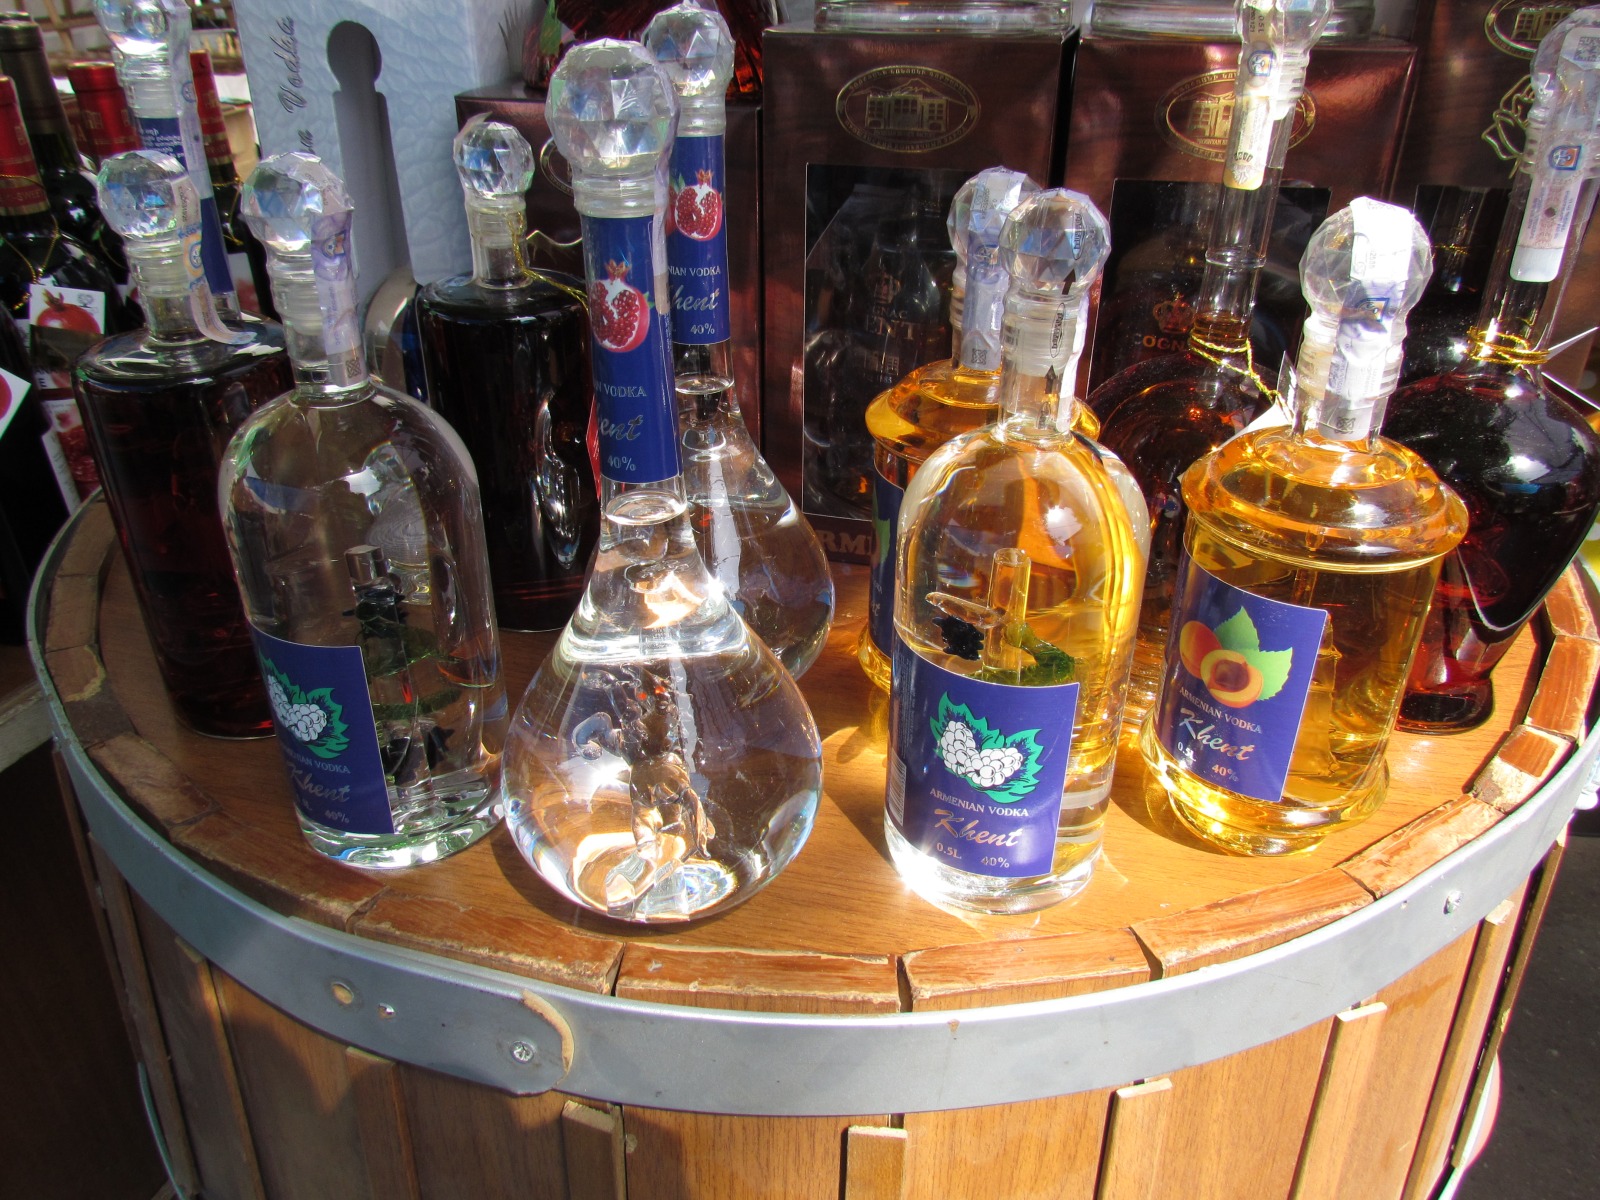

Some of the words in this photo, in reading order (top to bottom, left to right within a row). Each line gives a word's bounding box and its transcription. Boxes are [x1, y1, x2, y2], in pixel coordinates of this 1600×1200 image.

[688, 265, 721, 277] VODKA
[670, 284, 721, 311] hent
[690, 322, 715, 335] 40%
[604, 385, 647, 398] VODKA
[607, 453, 637, 472] 40%
[1179, 686, 1222, 719] ARMENIAN
[1224, 713, 1263, 734] VODKA
[1179, 707, 1255, 761] Khent
[314, 759, 351, 774] VODKA
[1211, 763, 1239, 782] 40%
[287, 760, 350, 803] Khent
[930, 787, 985, 813] ARMENIAN
[988, 806, 1029, 818] VODKA
[324, 810, 350, 824] 40%
[934, 808, 1023, 847] Khent
[936, 842, 963, 860] 0.5L
[980, 855, 1010, 869] 40%
